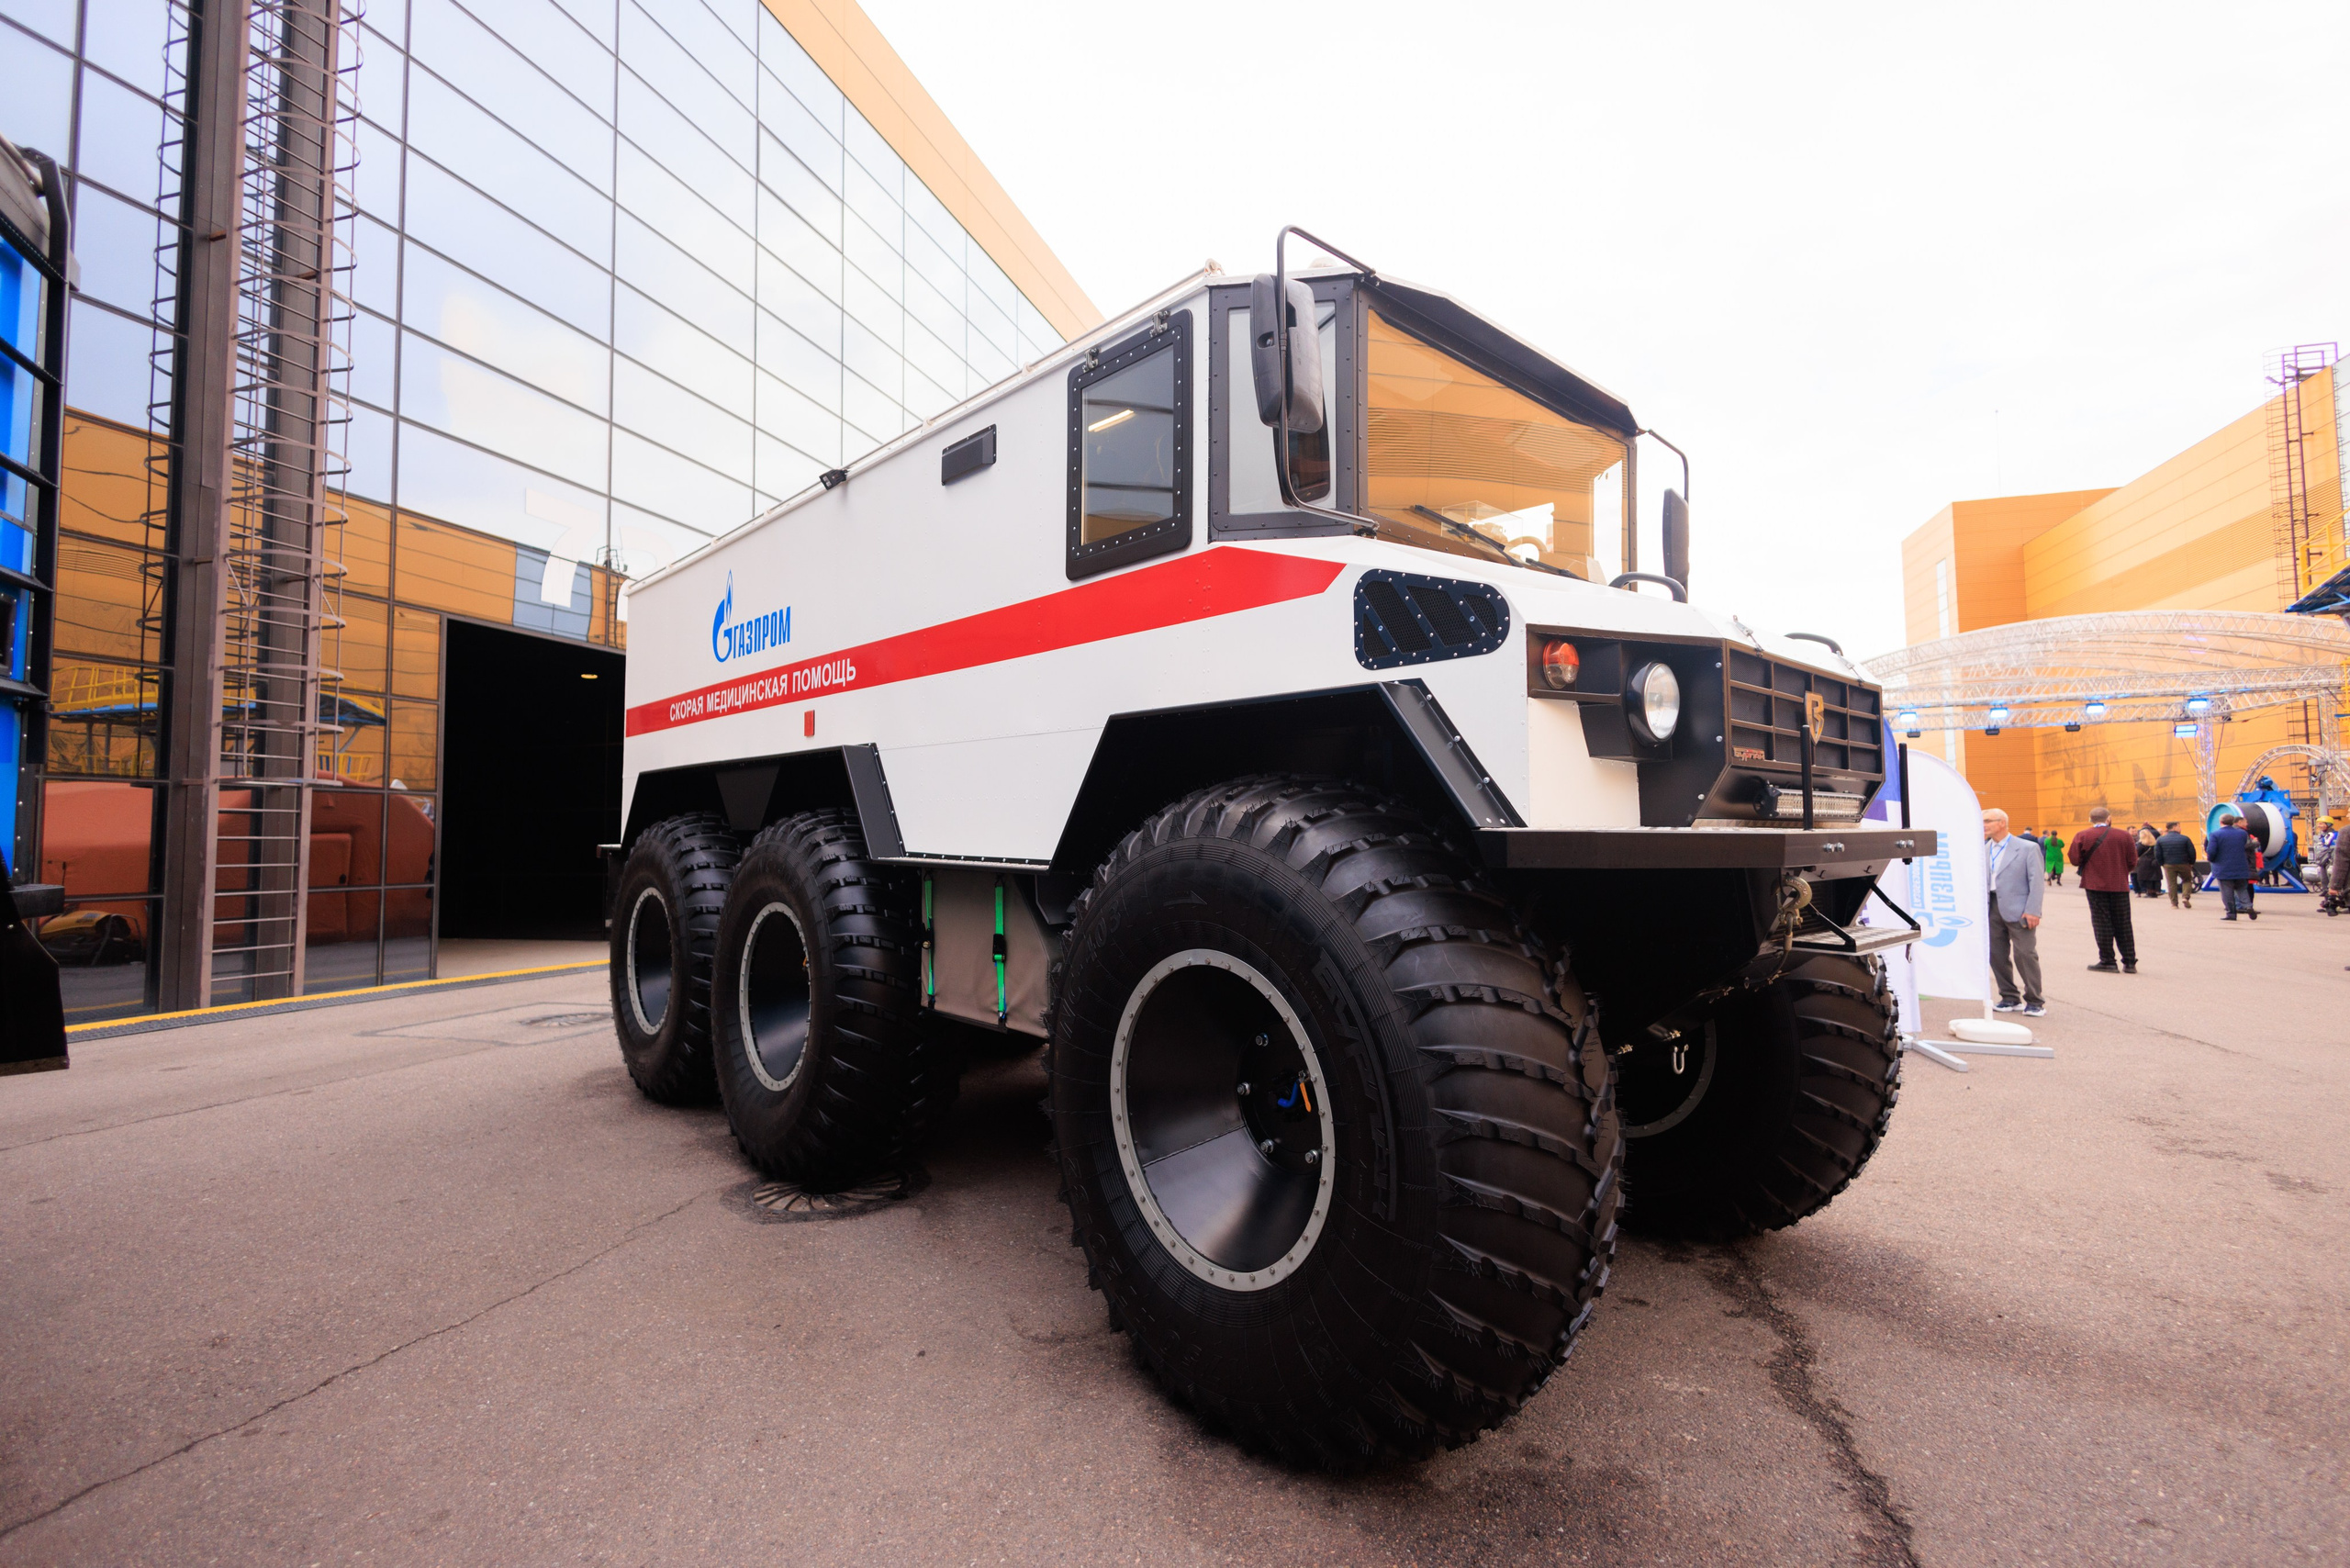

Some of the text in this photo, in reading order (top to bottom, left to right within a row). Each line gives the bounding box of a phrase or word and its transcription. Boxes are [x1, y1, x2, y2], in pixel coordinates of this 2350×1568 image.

[733, 606, 791, 659] ГАЗПРОМ
[669, 658, 856, 722] СКОРАЯ МЕДИЦИНСКАЯ ПОМОЩЬ
